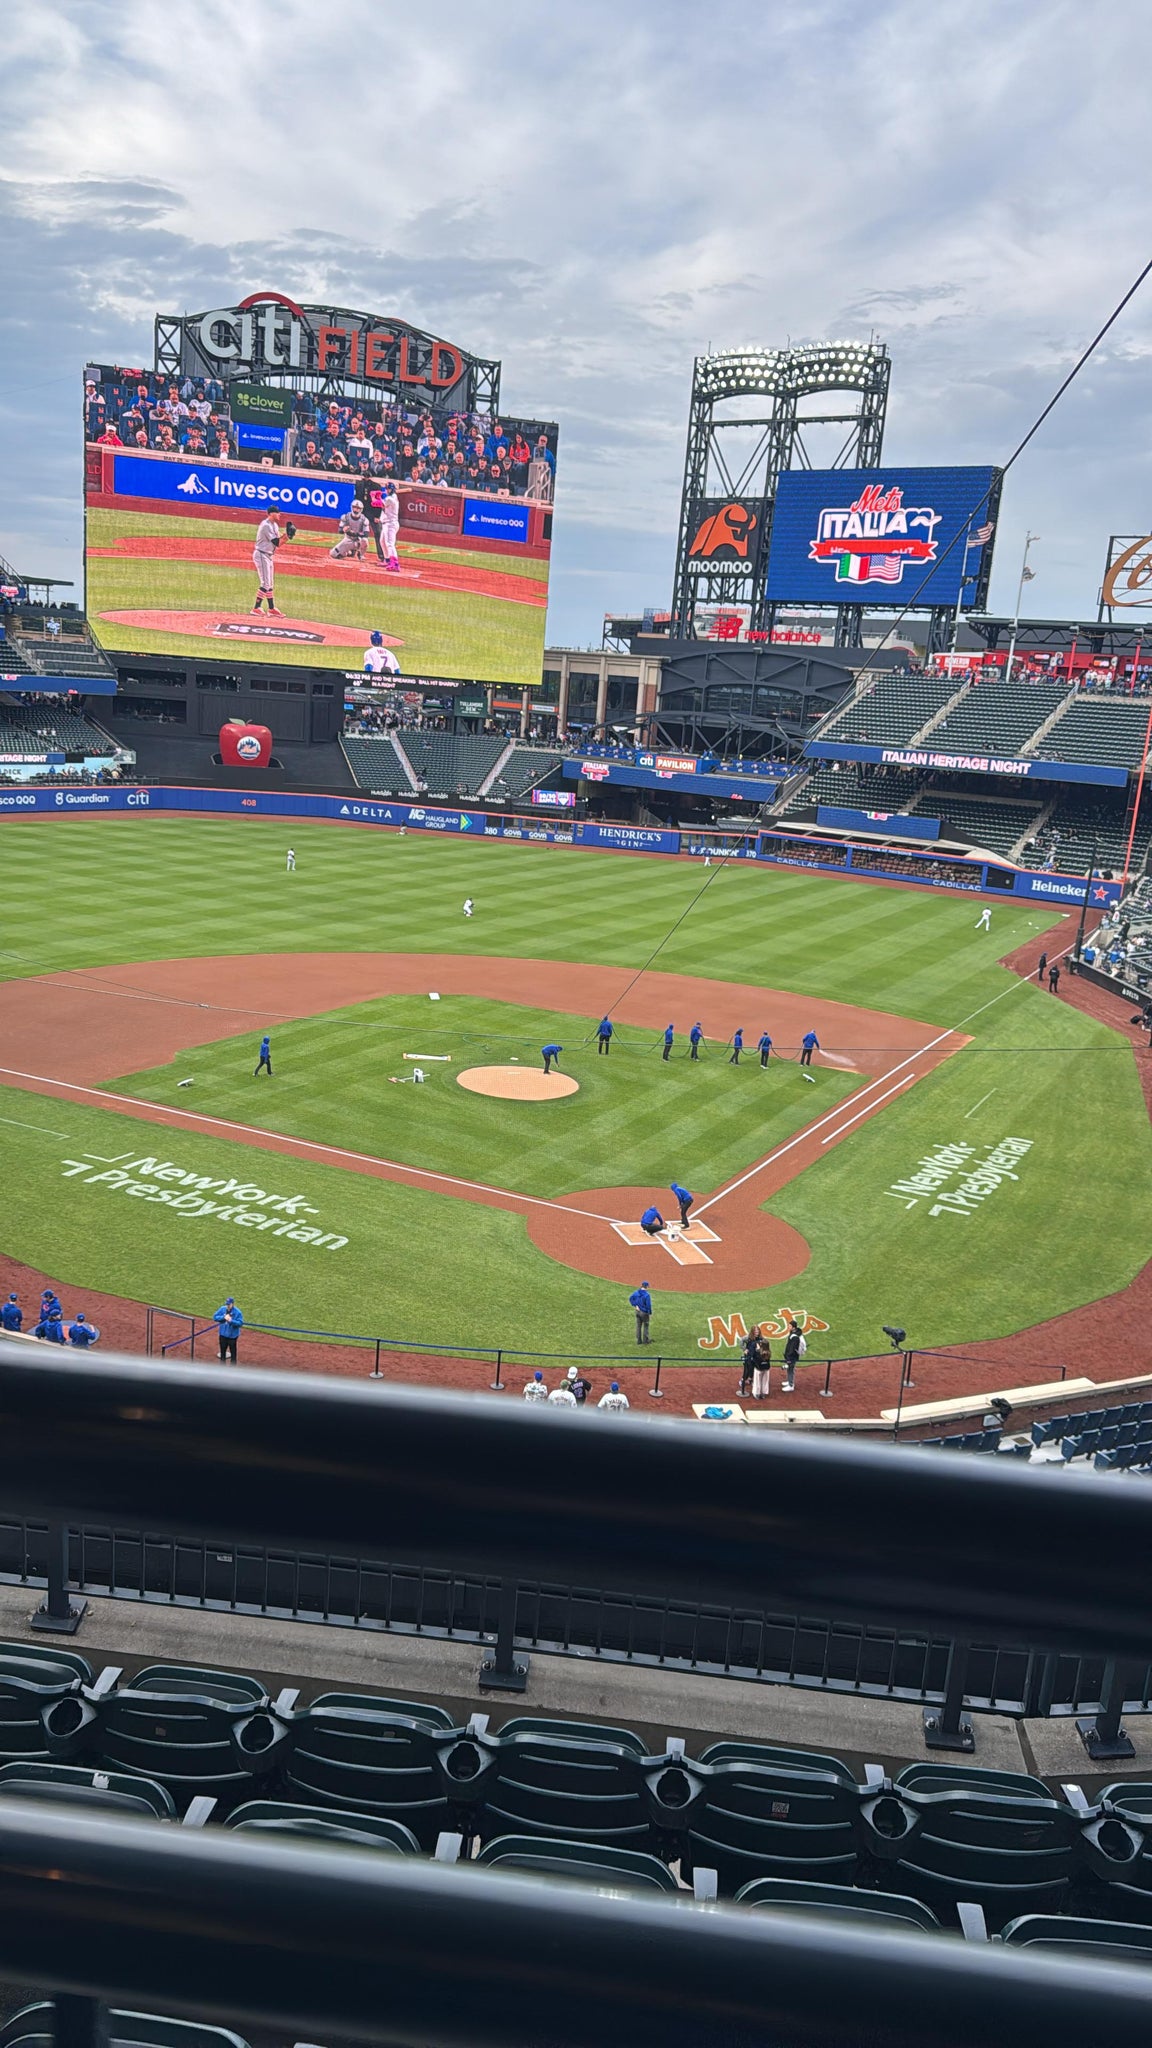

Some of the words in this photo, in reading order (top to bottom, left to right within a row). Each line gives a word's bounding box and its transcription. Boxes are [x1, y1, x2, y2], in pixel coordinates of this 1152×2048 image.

[200, 304, 301, 368] citi
[317, 325, 463, 388] FIELD
[249, 395, 285, 410] clover
[214, 475, 293, 503] Invesco
[296, 487, 339, 509] QQQ
[850, 484, 904, 513] Mets
[429, 506, 455, 518] FIELD
[481, 515, 507, 526] Invesco
[508, 518, 524, 529] QQQ
[687, 560, 753, 575] moomoo
[743, 629, 769, 642] new
[770, 629, 822, 644] balance
[381, 655, 388, 667] 7
[24, 755, 48, 763] NIGHT
[640, 755, 653, 767] citi
[657, 759, 694, 771] PAVILION
[882, 750, 927, 766] ITALIAN
[929, 754, 988, 771] HERITAGE
[990, 761, 1032, 775] NIGHT
[15, 795, 36, 805] QQQ
[65, 793, 110, 804] Guardian
[127, 792, 150, 805] citi
[241, 799, 257, 807] 408
[352, 806, 392, 819] DELTA
[425, 815, 459, 825] HAUGLAND
[425, 821, 446, 829] GROUP
[484, 827, 498, 835] 380
[503, 828, 522, 837] GOYA
[529, 831, 547, 840] GOYA
[554, 834, 573, 842] GOYA
[599, 828, 663, 842] HENDRICK'S
[745, 850, 757, 858] 370
[777, 857, 819, 868] CADILLAC
[932, 879, 982, 892] CADILLAC
[936, 1136, 1035, 1208] Presbyterian
[83, 1169, 350, 1251] Presbyterian
[698, 1307, 830, 1351] Mets
